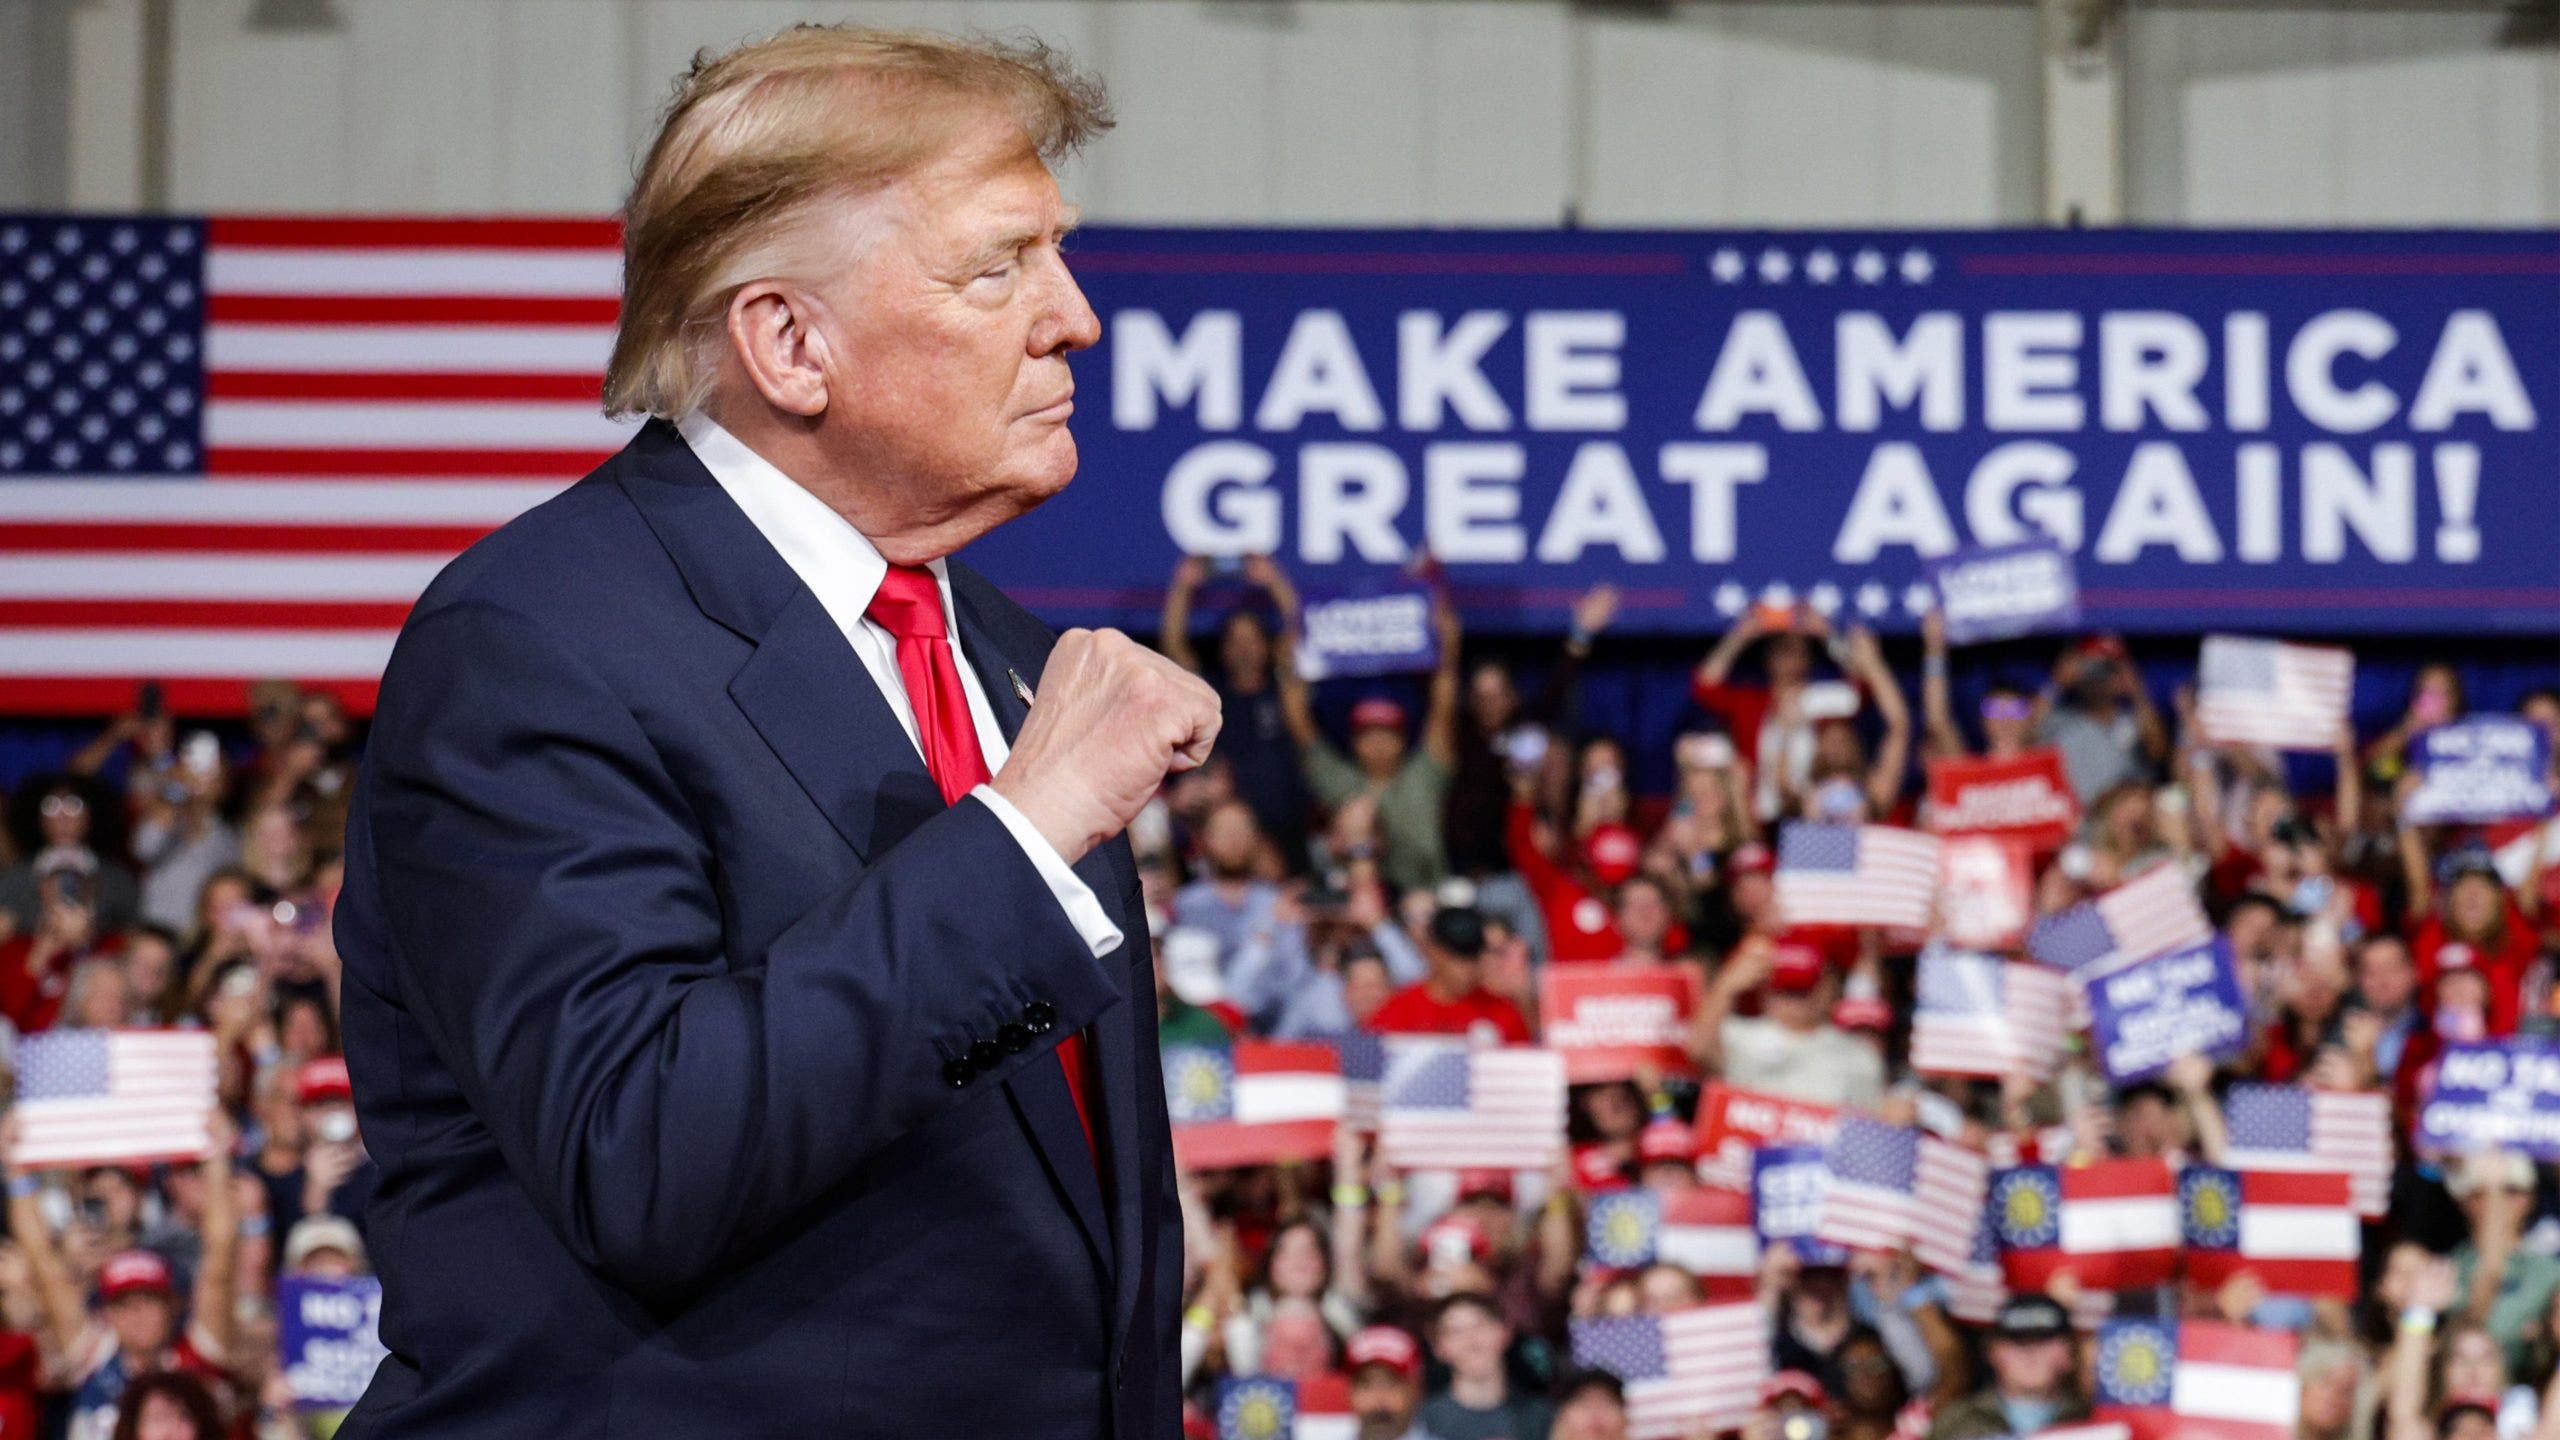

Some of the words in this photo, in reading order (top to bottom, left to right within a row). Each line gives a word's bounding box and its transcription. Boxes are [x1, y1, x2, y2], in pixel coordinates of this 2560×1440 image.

[1111, 311, 1628, 431] MAKE
[1695, 310, 2536, 433] AMERICA
[1161, 441, 1768, 563] GREAT
[1833, 441, 2481, 563] AGAIN!
[2442, 1051, 2507, 1089] NO
[2511, 1053, 2560, 1094] TA
